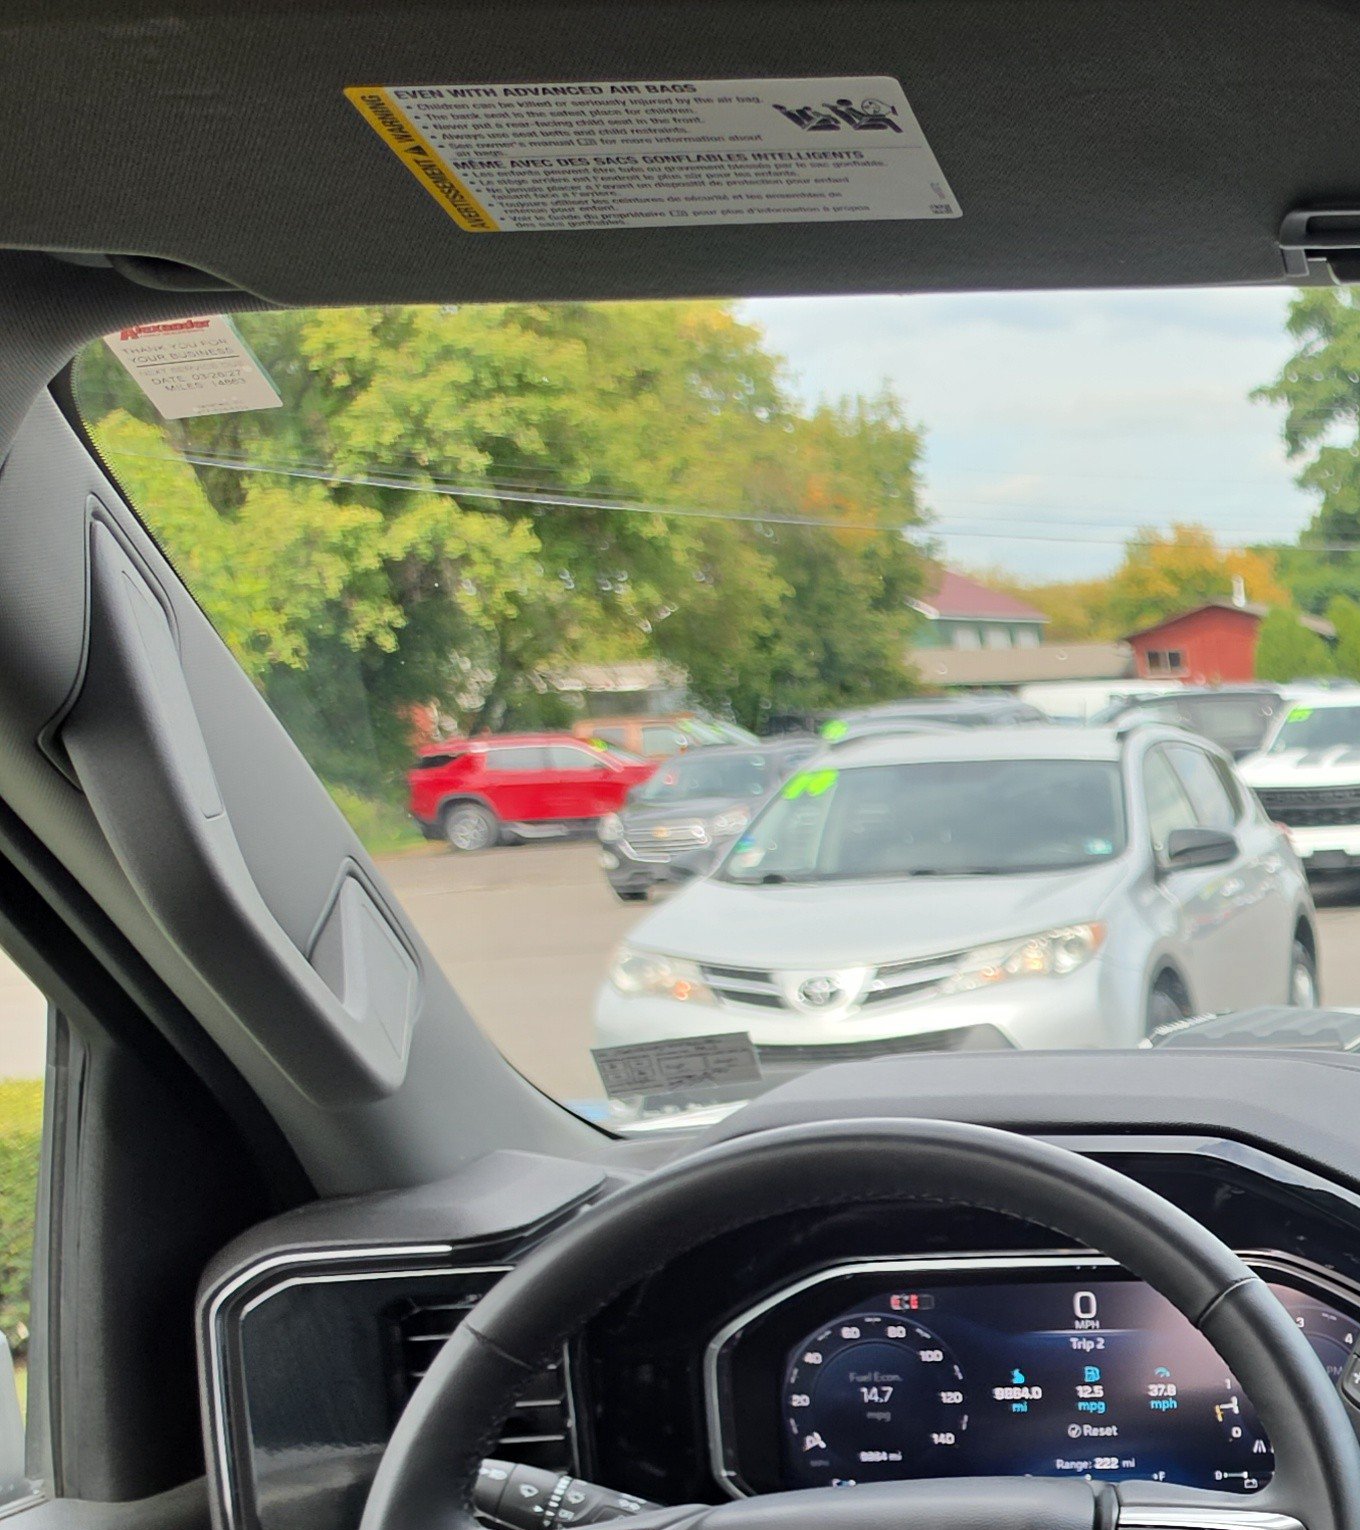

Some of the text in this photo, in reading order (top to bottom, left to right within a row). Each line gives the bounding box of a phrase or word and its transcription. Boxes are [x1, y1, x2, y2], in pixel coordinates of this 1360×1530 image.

[394, 83, 698, 100] EVEN WITH ADVANCED AIR BAGS
[417, 101, 469, 111] Children
[360, 94, 415, 144] WARNING
[452, 150, 864, 170] MÊME AVEC DES SACS GONFLABLES INTELLIGENTS
[1073, 1290, 1098, 1319] 0
[1074, 1320, 1100, 1330] MPH
[1070, 1338, 1106, 1352] Trip 2
[1344, 1332, 1353, 1345] 4
[919, 1349, 944, 1362] 100
[849, 1371, 871, 1382] Fuel
[860, 1386, 894, 1404] 14.7
[940, 1391, 964, 1404] 120
[1012, 1401, 1028, 1413] mi
[1078, 1401, 1107, 1414] mpg
[1150, 1398, 1178, 1412] mph
[1083, 1424, 1119, 1438] Reset
[932, 1432, 956, 1445] 140
[1055, 1458, 1092, 1472] Range:
